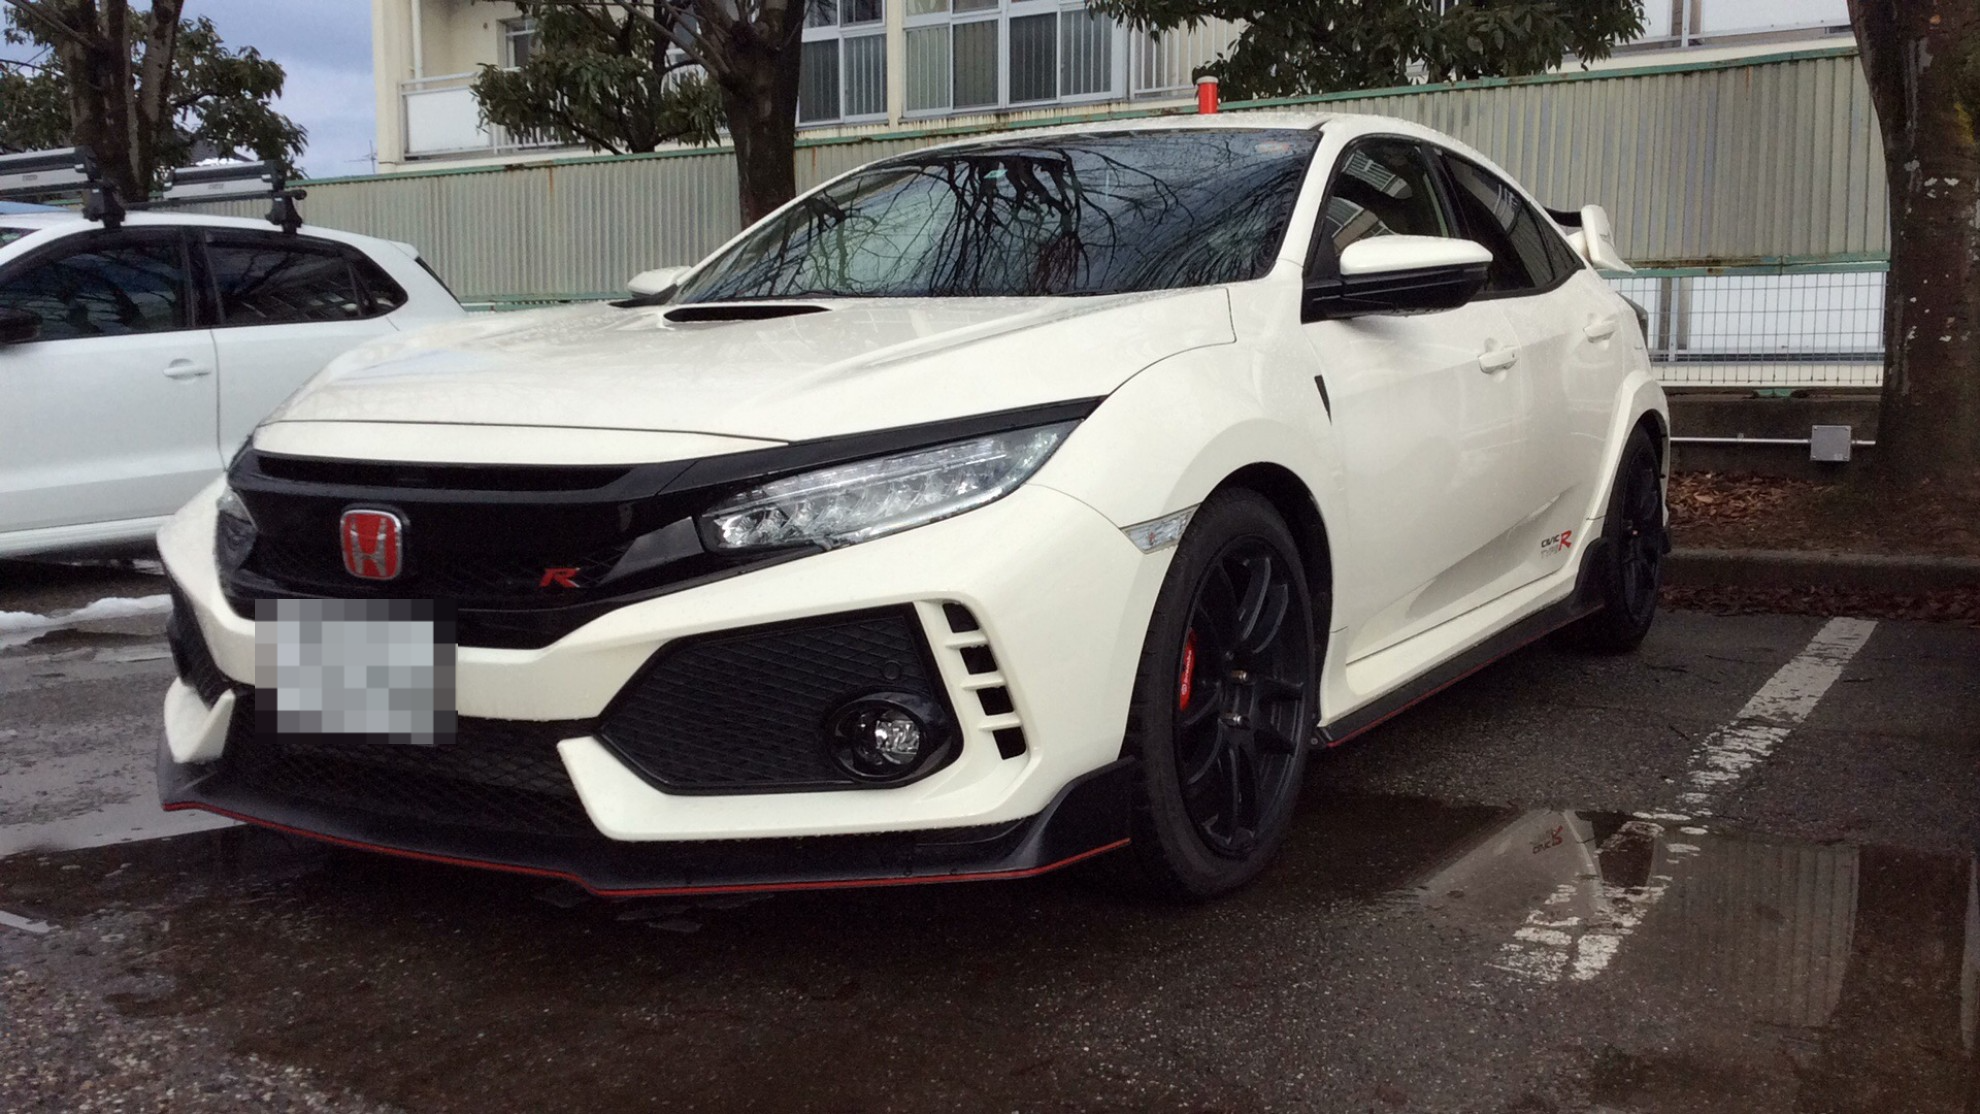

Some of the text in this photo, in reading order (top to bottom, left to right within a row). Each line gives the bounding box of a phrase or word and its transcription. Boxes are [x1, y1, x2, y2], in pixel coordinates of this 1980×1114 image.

[350, 517, 387, 576] H
[1558, 529, 1572, 552] R
[540, 567, 581, 588] R
